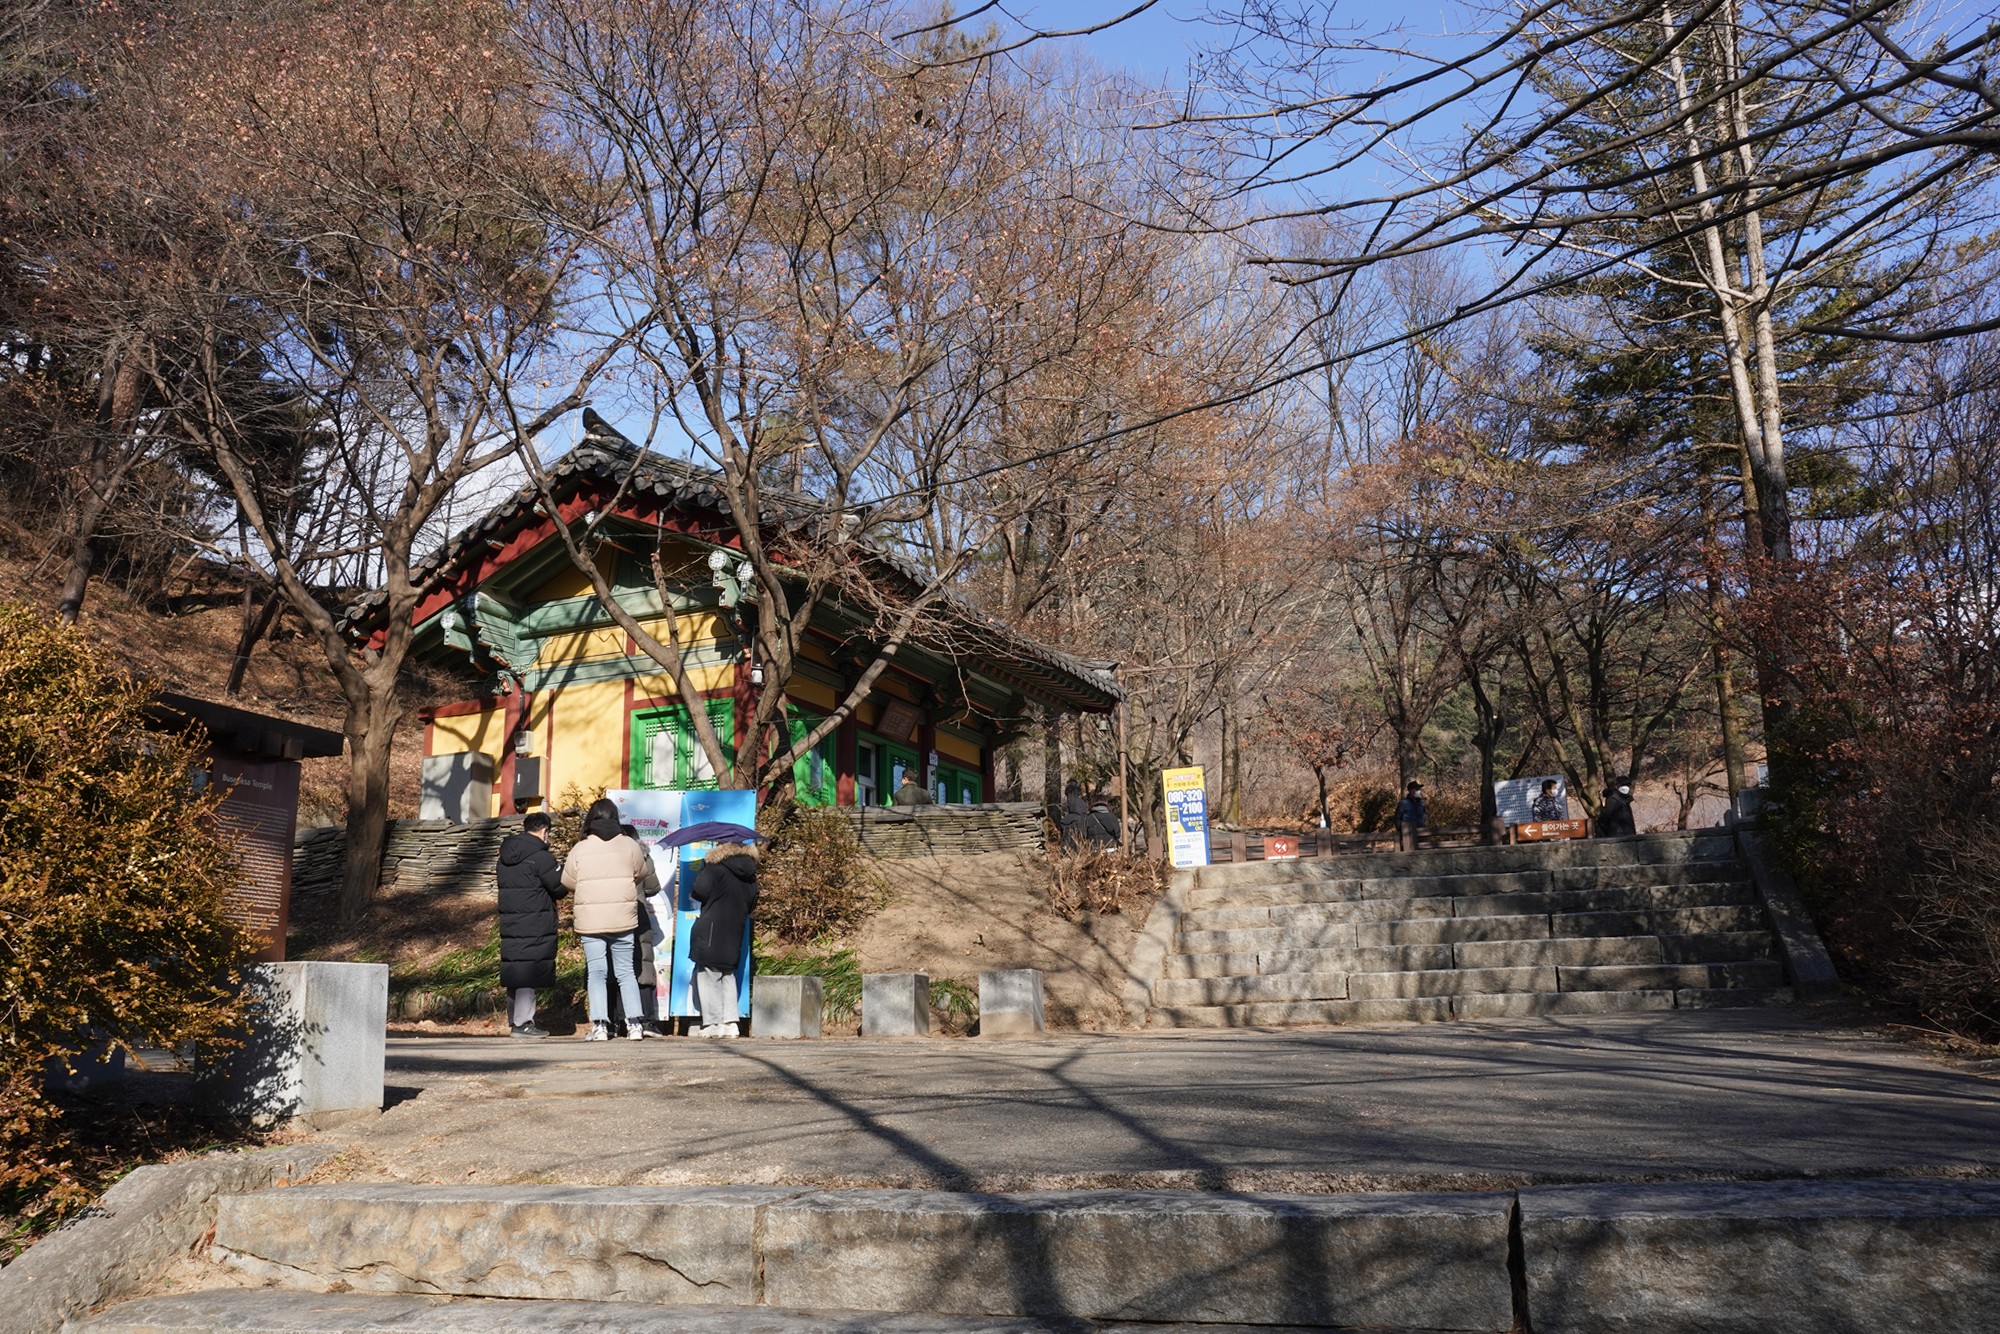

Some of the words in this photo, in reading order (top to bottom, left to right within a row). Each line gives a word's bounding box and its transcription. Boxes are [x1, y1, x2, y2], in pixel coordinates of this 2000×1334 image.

[252, 779, 273, 791] Temple
[1167, 789, 1203, 803] 080-320
[629, 818, 656, 827] 경북관광
[1541, 822, 1569, 831] 들어가는
[1571, 821, 1579, 830] 곳
[637, 828, 668, 837] 린지투어
